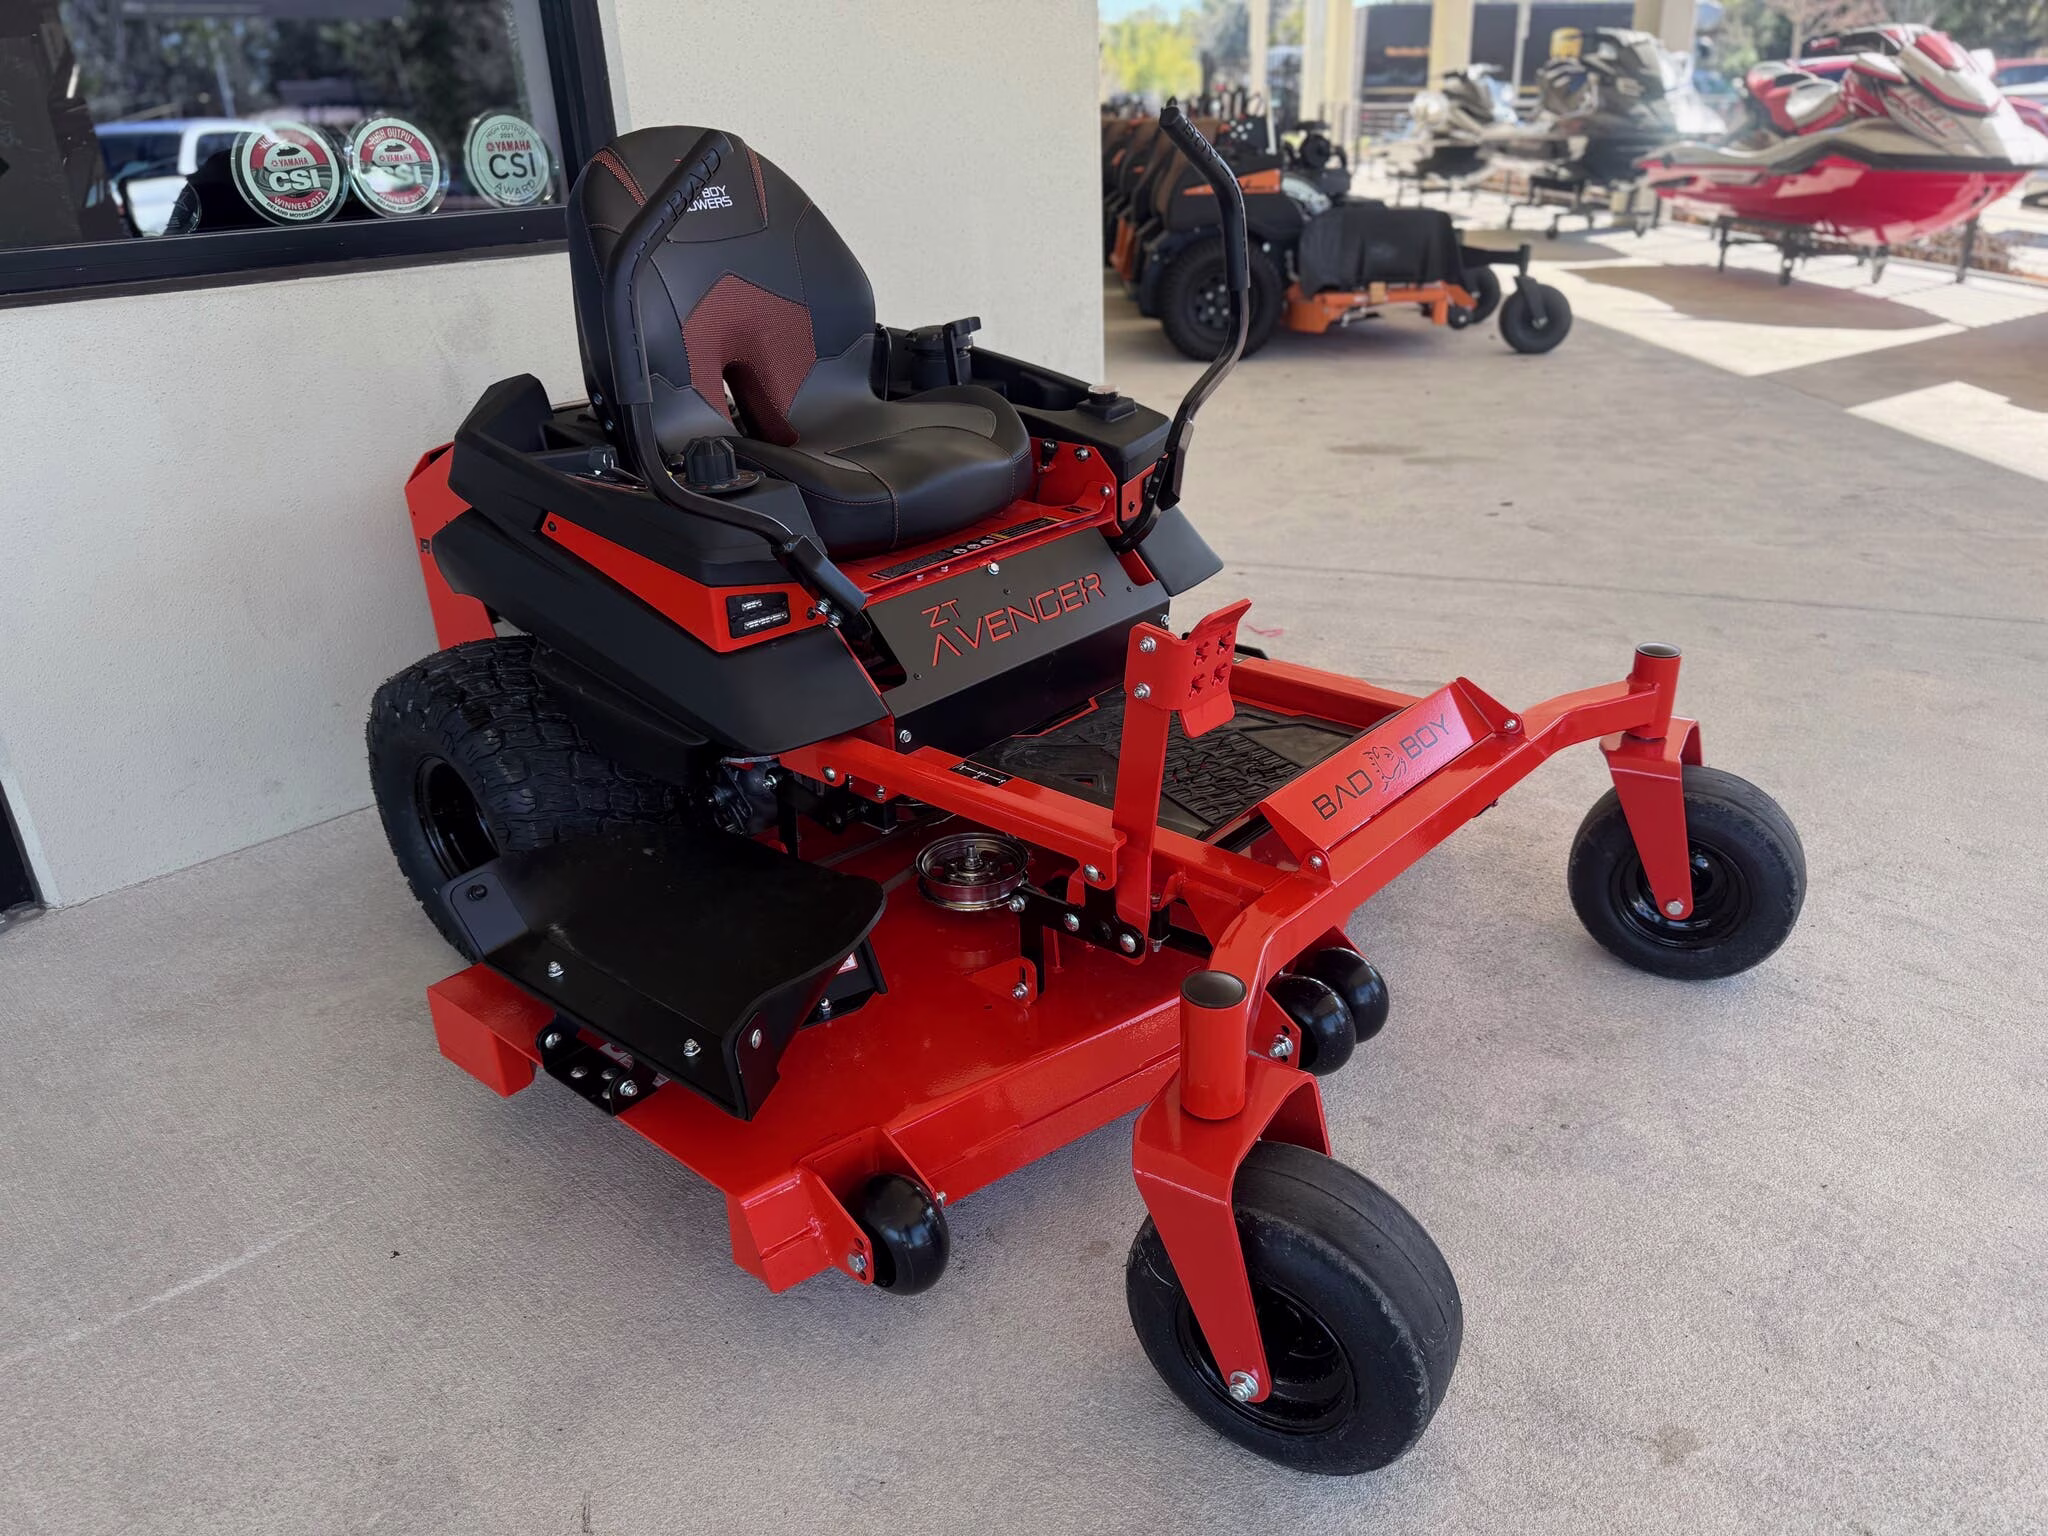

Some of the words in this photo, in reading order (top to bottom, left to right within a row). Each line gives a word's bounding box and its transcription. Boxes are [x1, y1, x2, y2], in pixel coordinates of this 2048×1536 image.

[387, 127, 415, 144] OUTPUT
[495, 141, 531, 152] YAMAHA
[279, 157, 309, 167] YAMAHA
[385, 153, 413, 163] YAMAHA
[489, 152, 536, 179] CSI
[268, 169, 321, 192] CSI
[494, 179, 536, 195] AWARD
[701, 185, 726, 198] BOY
[274, 196, 308, 210] WINNER
[921, 598, 960, 628] ZT
[931, 572, 1106, 667] AVENGER
[1312, 769, 1374, 821] BAD
[1400, 714, 1450, 760] BOY
